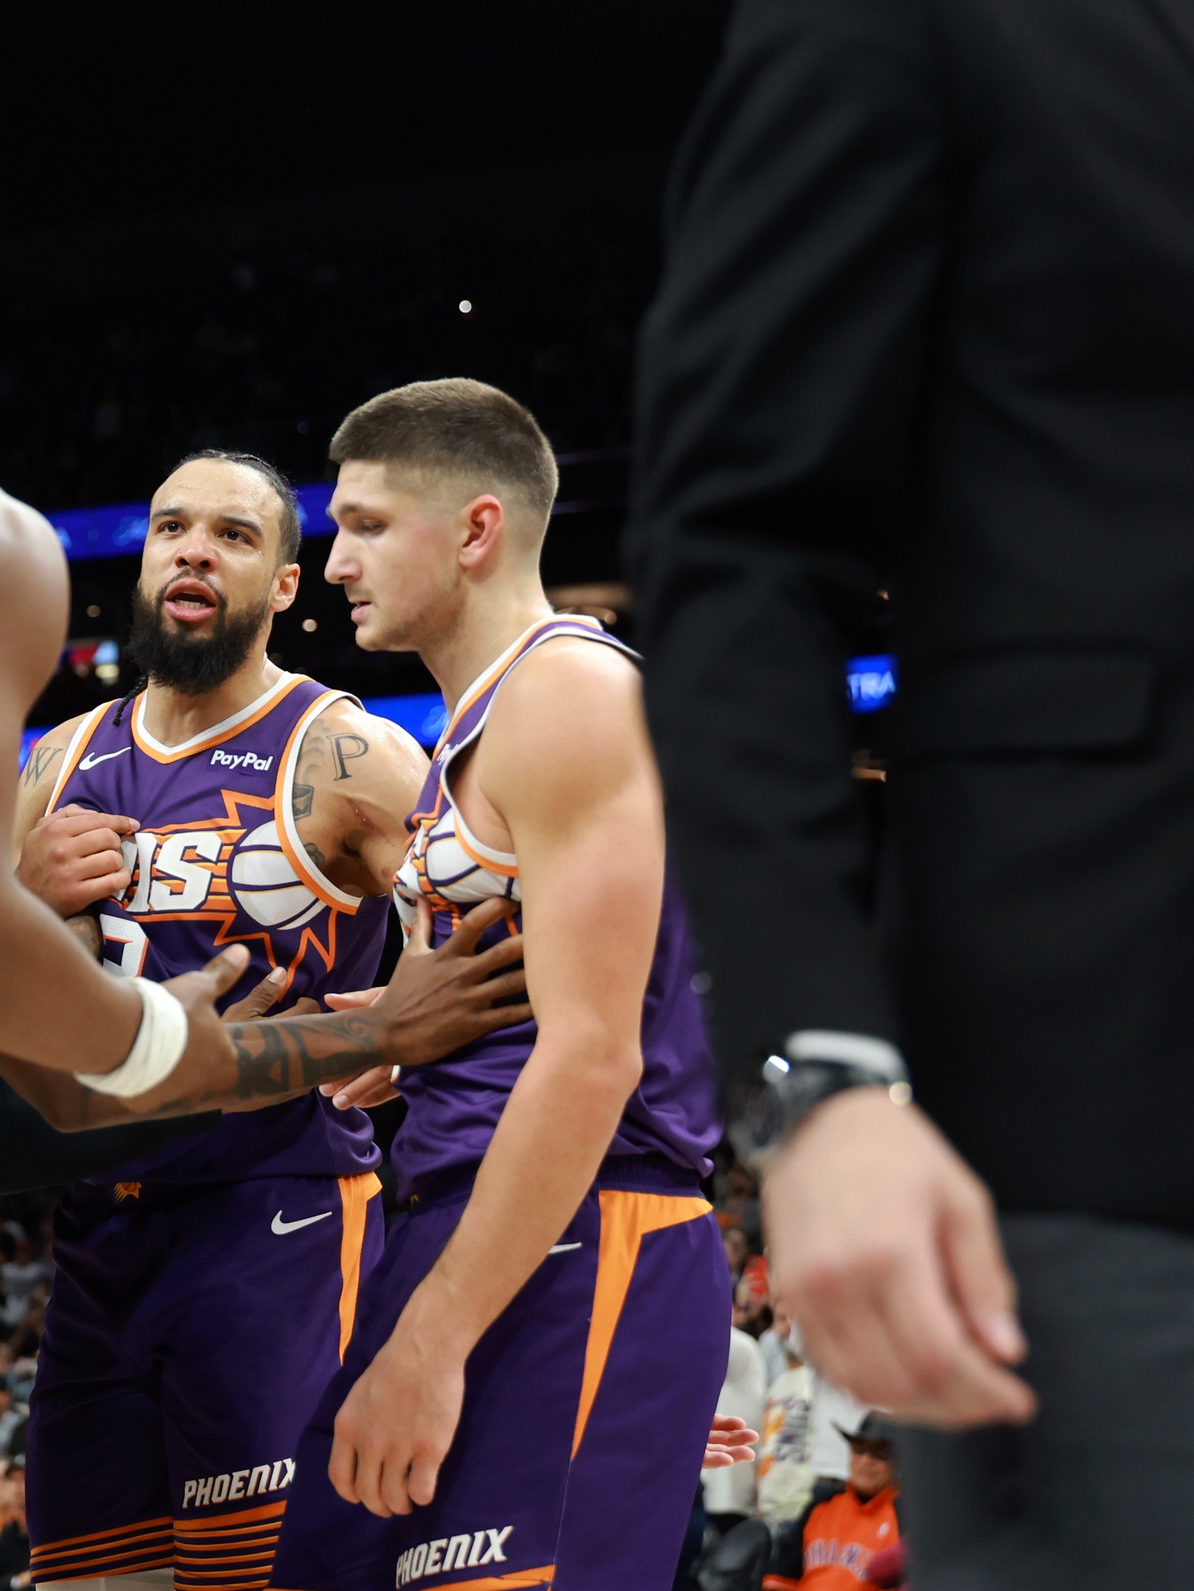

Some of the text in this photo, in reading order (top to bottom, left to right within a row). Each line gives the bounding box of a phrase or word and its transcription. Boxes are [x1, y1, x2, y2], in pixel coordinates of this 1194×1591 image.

[210, 749, 274, 771] PayPal
[326, 732, 369, 781] P
[182, 1457, 296, 1510] PHOENIX
[396, 1525, 514, 1591] PHOENIX
